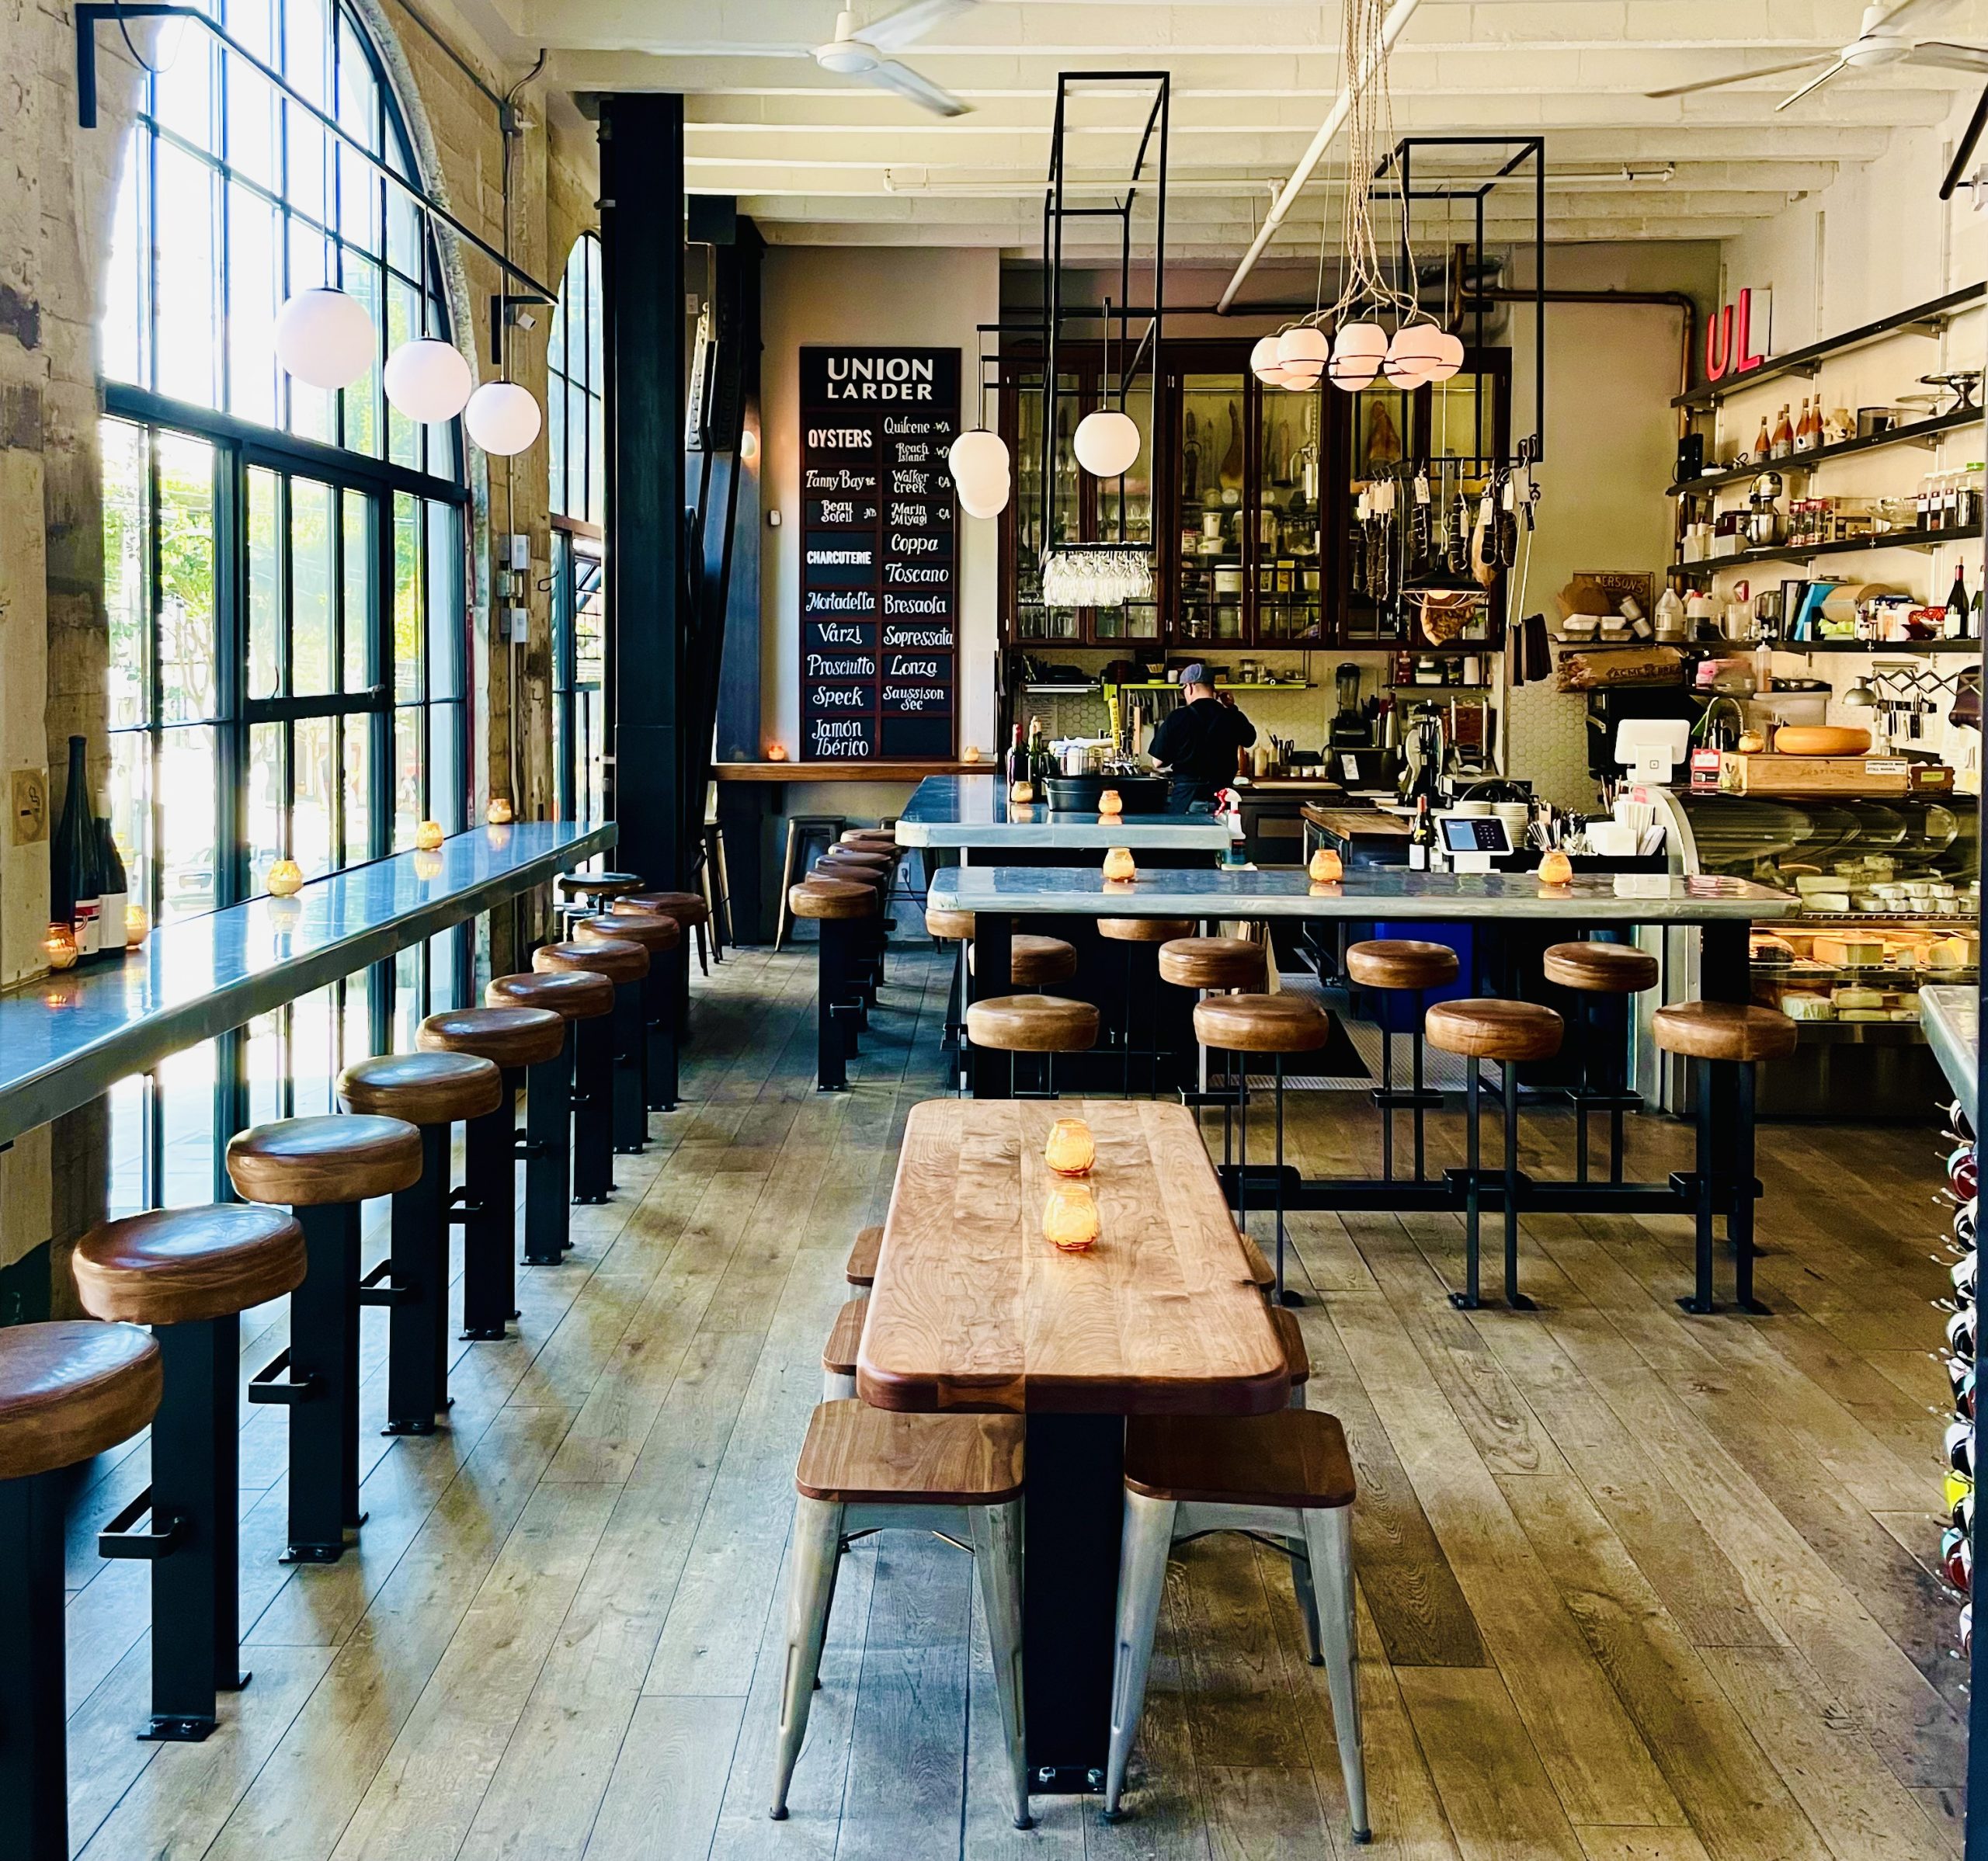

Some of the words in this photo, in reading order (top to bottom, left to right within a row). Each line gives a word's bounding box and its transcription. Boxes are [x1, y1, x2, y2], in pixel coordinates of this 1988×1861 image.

[1707, 288, 1764, 381] UL
[829, 358, 933, 380] UNION
[828, 383, 932, 400] LARDER
[885, 416, 930, 434] Quilcene
[808, 429, 872, 448] OYSTERS
[895, 442, 930, 455] Reach
[898, 451, 926, 462] Island
[806, 470, 839, 491] Fanny
[839, 469, 865, 491] Bay
[892, 470, 929, 482] Walker
[894, 481, 926, 494] Creek
[821, 500, 853, 513] Beau
[891, 503, 926, 515] Marin
[821, 511, 853, 523] Soleil
[891, 514, 926, 526] Miyagi
[891, 533, 938, 554] Coppa
[807, 551, 871, 564] CHARCUTERIE
[885, 563, 948, 582] Toscano
[806, 592, 875, 611] Mortadella
[884, 595, 946, 614] Bresaola
[818, 623, 862, 644] Varzi
[883, 625, 954, 647] Sopressata
[807, 654, 874, 675] Prosciutto
[891, 655, 937, 677] Lonza
[813, 686, 864, 707] Speck
[883, 686, 944, 700] Saussison
[901, 698, 923, 710] Sec
[812, 719, 862, 739] Jamón
[815, 737, 868, 756] Ibérico
